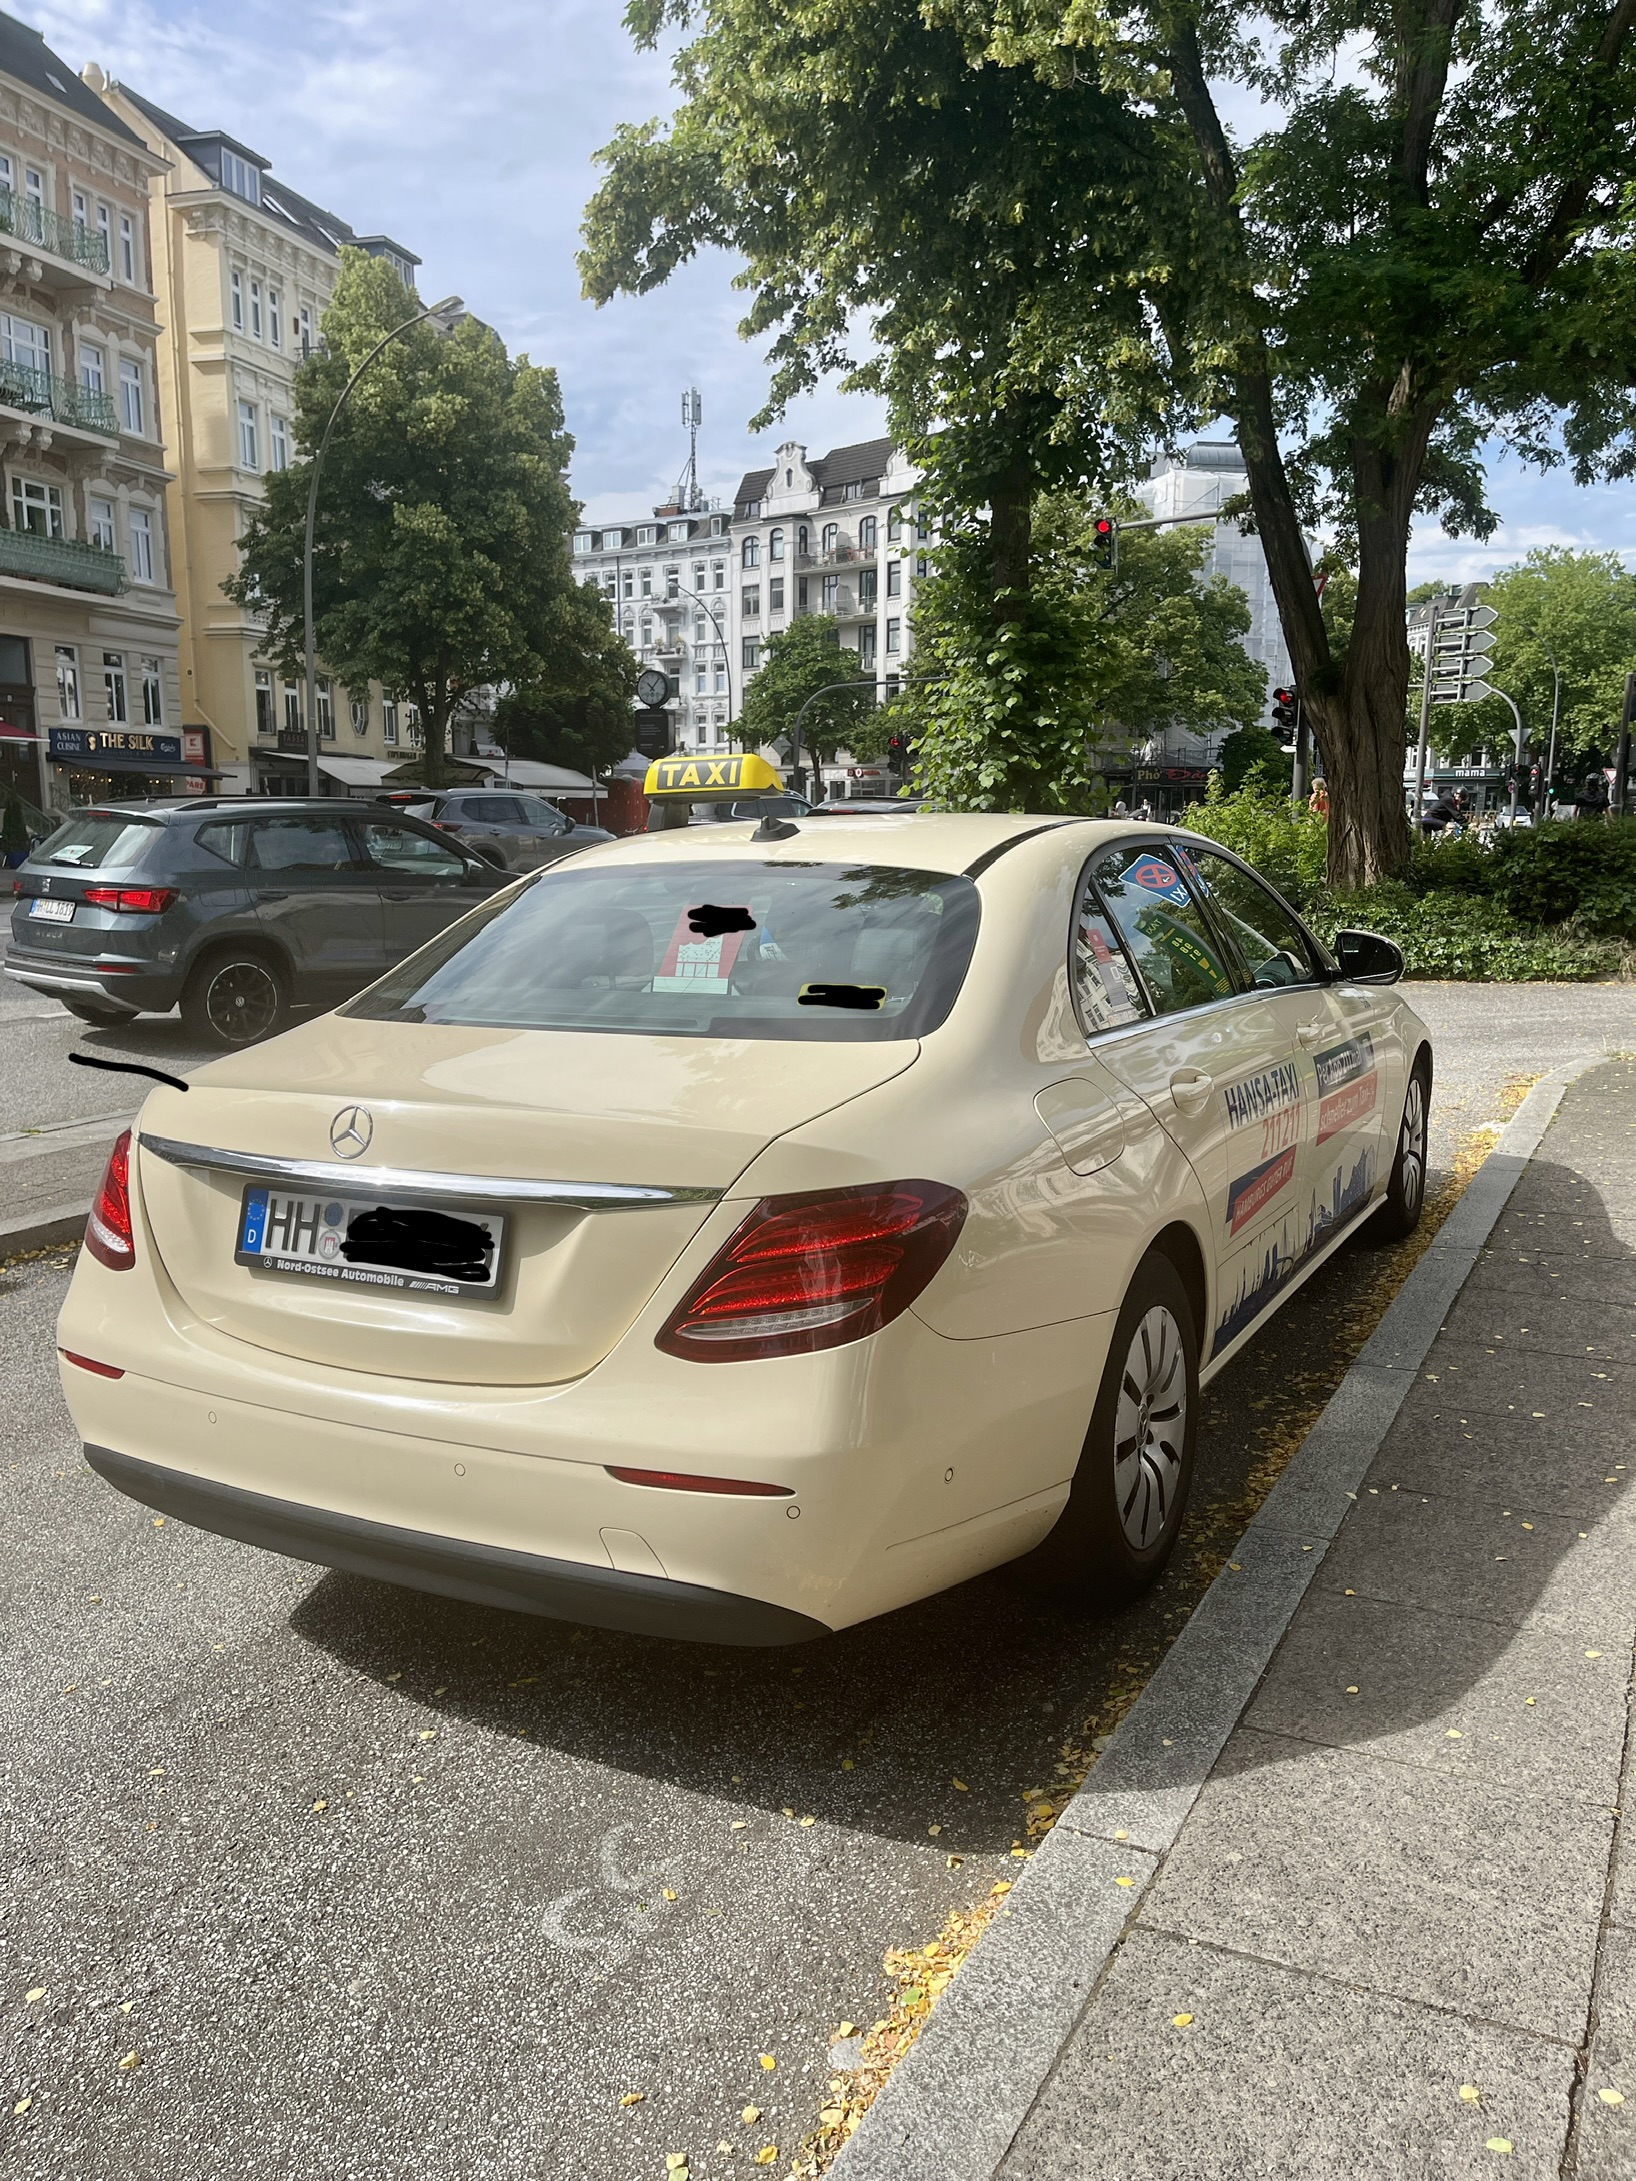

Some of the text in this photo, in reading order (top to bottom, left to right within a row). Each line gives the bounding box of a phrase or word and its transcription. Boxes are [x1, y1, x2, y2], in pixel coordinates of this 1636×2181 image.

[56, 732, 81, 742] ASIAN
[56, 742, 81, 751] CUISINE
[100, 732, 155, 751] THE SILK
[189, 737, 197, 747] K
[661, 760, 739, 788] TAXI
[1455, 769, 1486, 777] mama
[1224, 1062, 1299, 1130] HANSA-TAXI
[1260, 1102, 1300, 1160] 211 211
[265, 1199, 322, 1254] HH
[247, 1230, 257, 1244] D
[277, 1259, 460, 1295] Nord-Ostsee Automobile AMG
